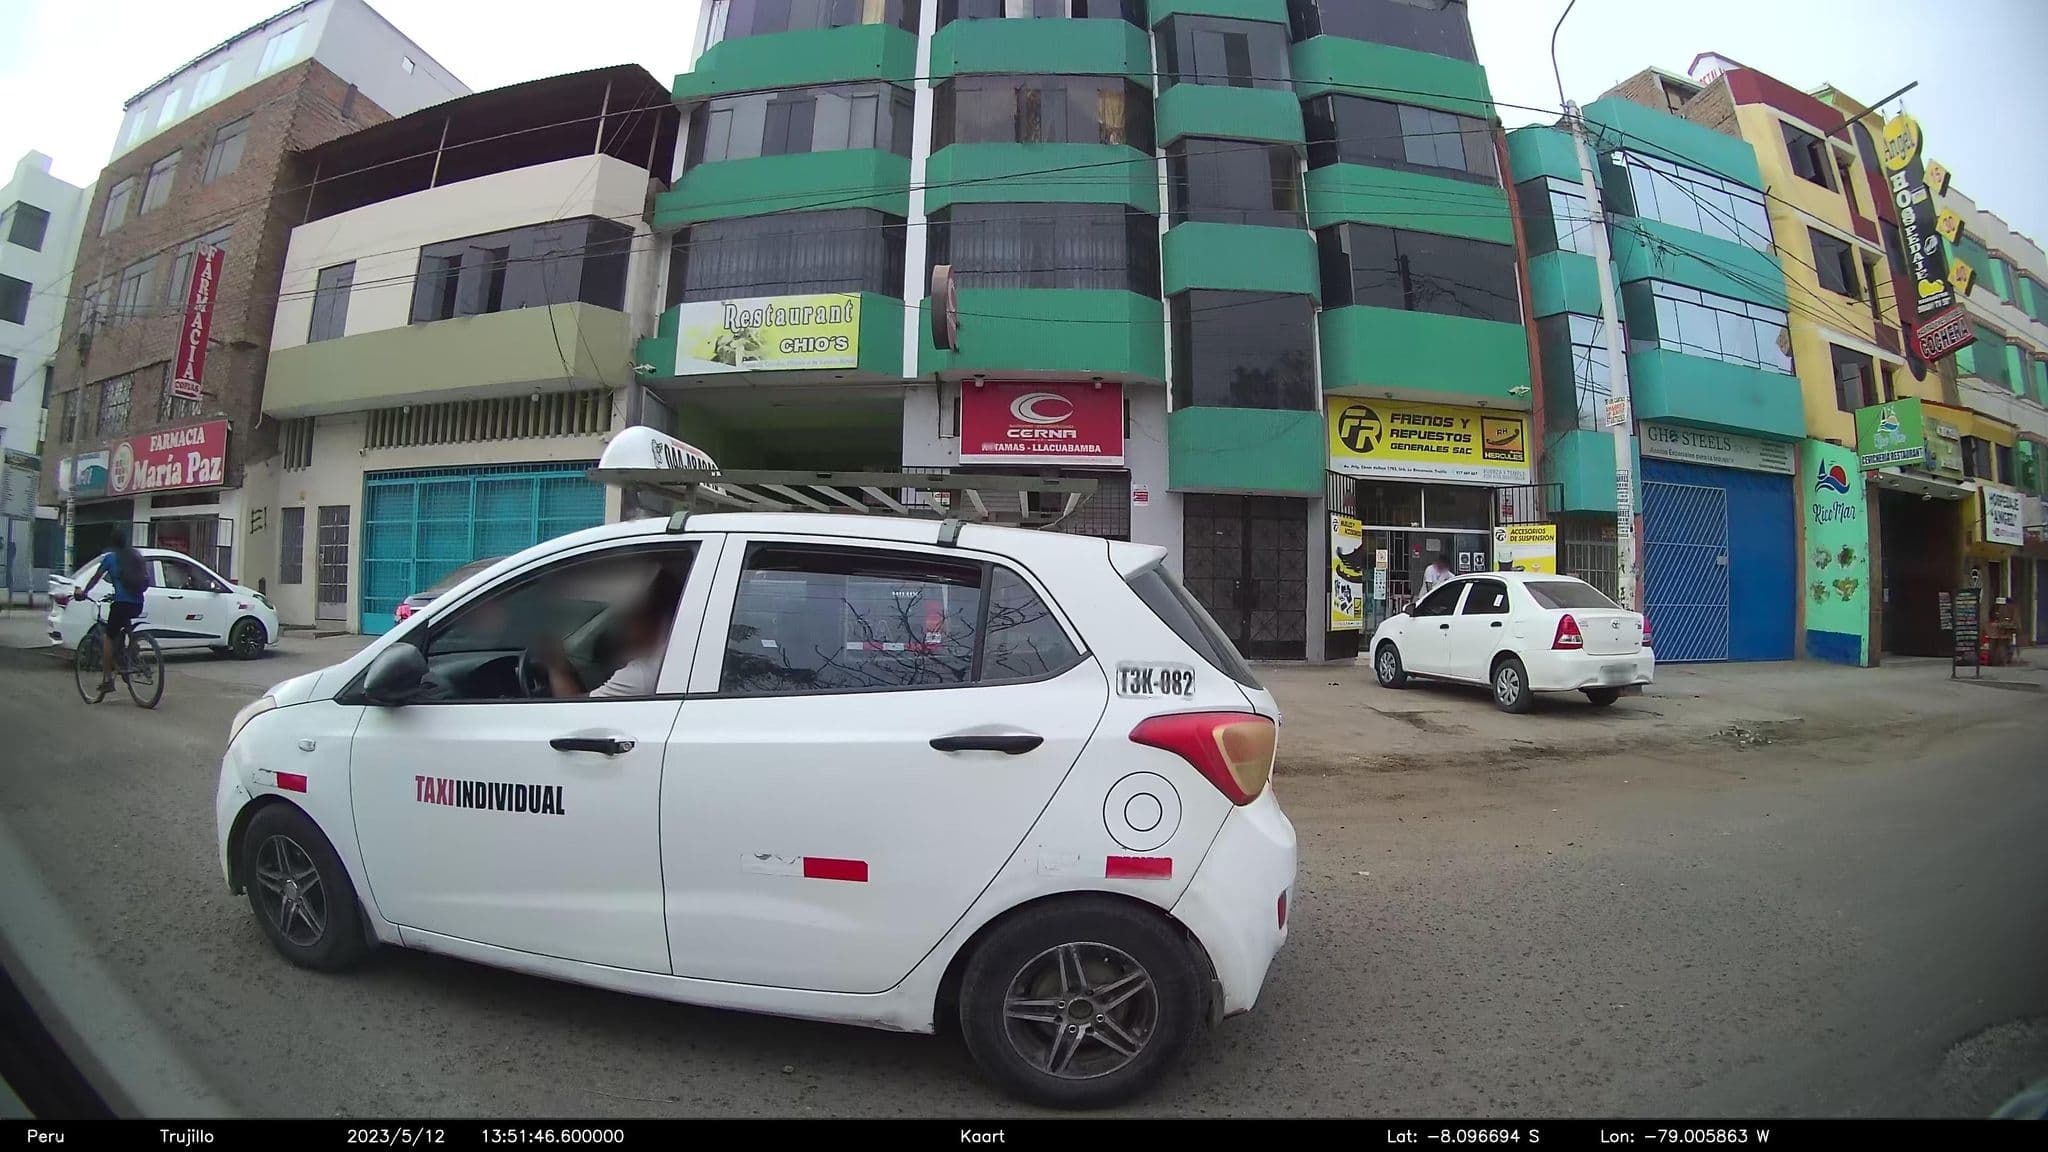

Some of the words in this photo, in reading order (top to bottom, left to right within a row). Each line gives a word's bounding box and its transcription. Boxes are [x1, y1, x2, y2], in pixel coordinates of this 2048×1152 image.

[1890, 170, 1928, 280] HOSPEDAJE
[183, 245, 217, 379] FARMACIA
[724, 300, 853, 332] Restaurant
[780, 336, 849, 353] CHIO'S
[1920, 318, 1970, 358] COCHERA
[1007, 429, 1077, 439] CERNA
[1460, 418, 1470, 429] Y
[150, 426, 205, 451] FARMACIA
[1390, 429, 1472, 443] REPUESTOS
[1682, 431, 1731, 451] STEELS
[1033, 444, 1101, 453] LLACUABAMBA
[1390, 443, 1449, 453] GENERALES
[1452, 446, 1472, 455] SAC
[187, 451, 222, 483] Paz
[1812, 503, 1833, 525] Rico
[1833, 501, 1856, 524] Mar
[1119, 667, 1194, 697] T3K-082
[415, 775, 454, 806] TAXI
[456, 780, 565, 815] INDIVIDUAL
